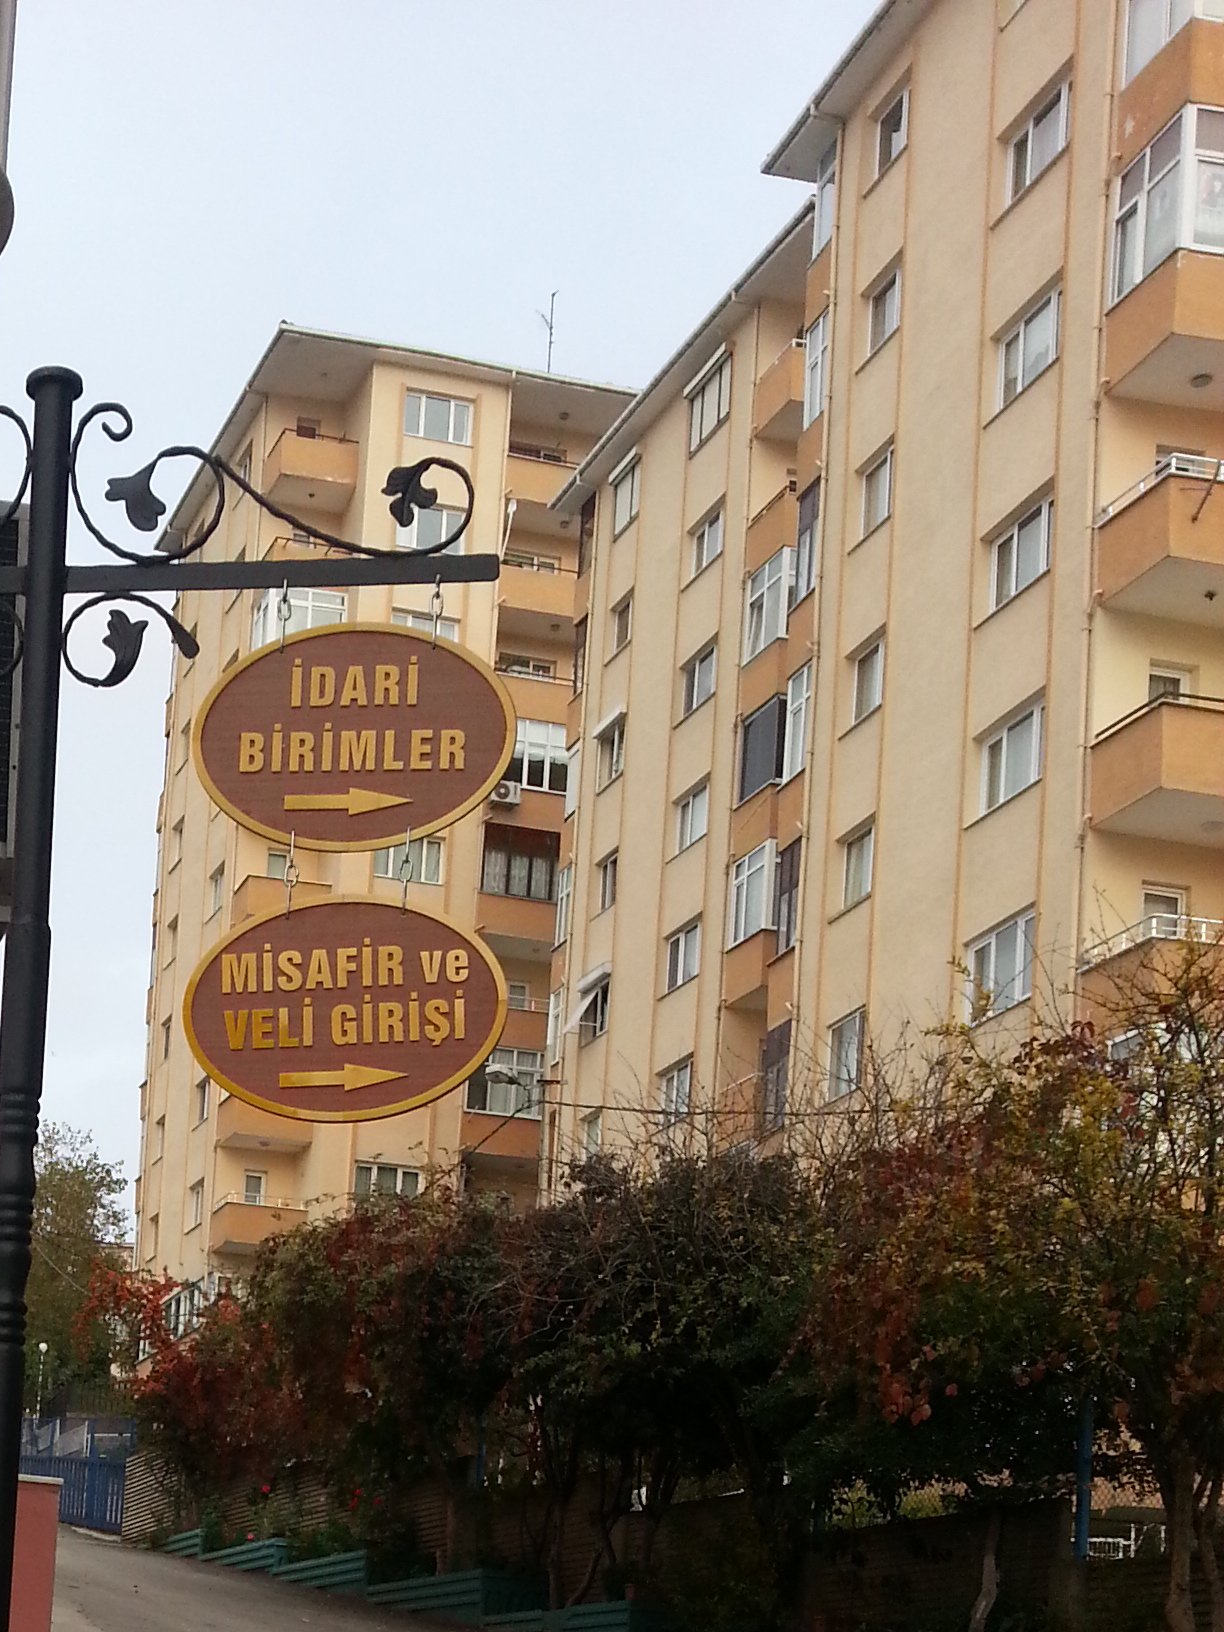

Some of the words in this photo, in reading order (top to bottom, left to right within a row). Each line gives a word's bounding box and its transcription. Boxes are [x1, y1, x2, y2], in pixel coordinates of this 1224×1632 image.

[290, 656, 419, 708] İDARİ
[238, 722, 466, 773] BİRİMLER
[220, 937, 404, 994] MİSAFİR
[420, 948, 469, 983] ve
[223, 997, 314, 1050] VELİ
[330, 989, 466, 1046] GİRİŞİ
